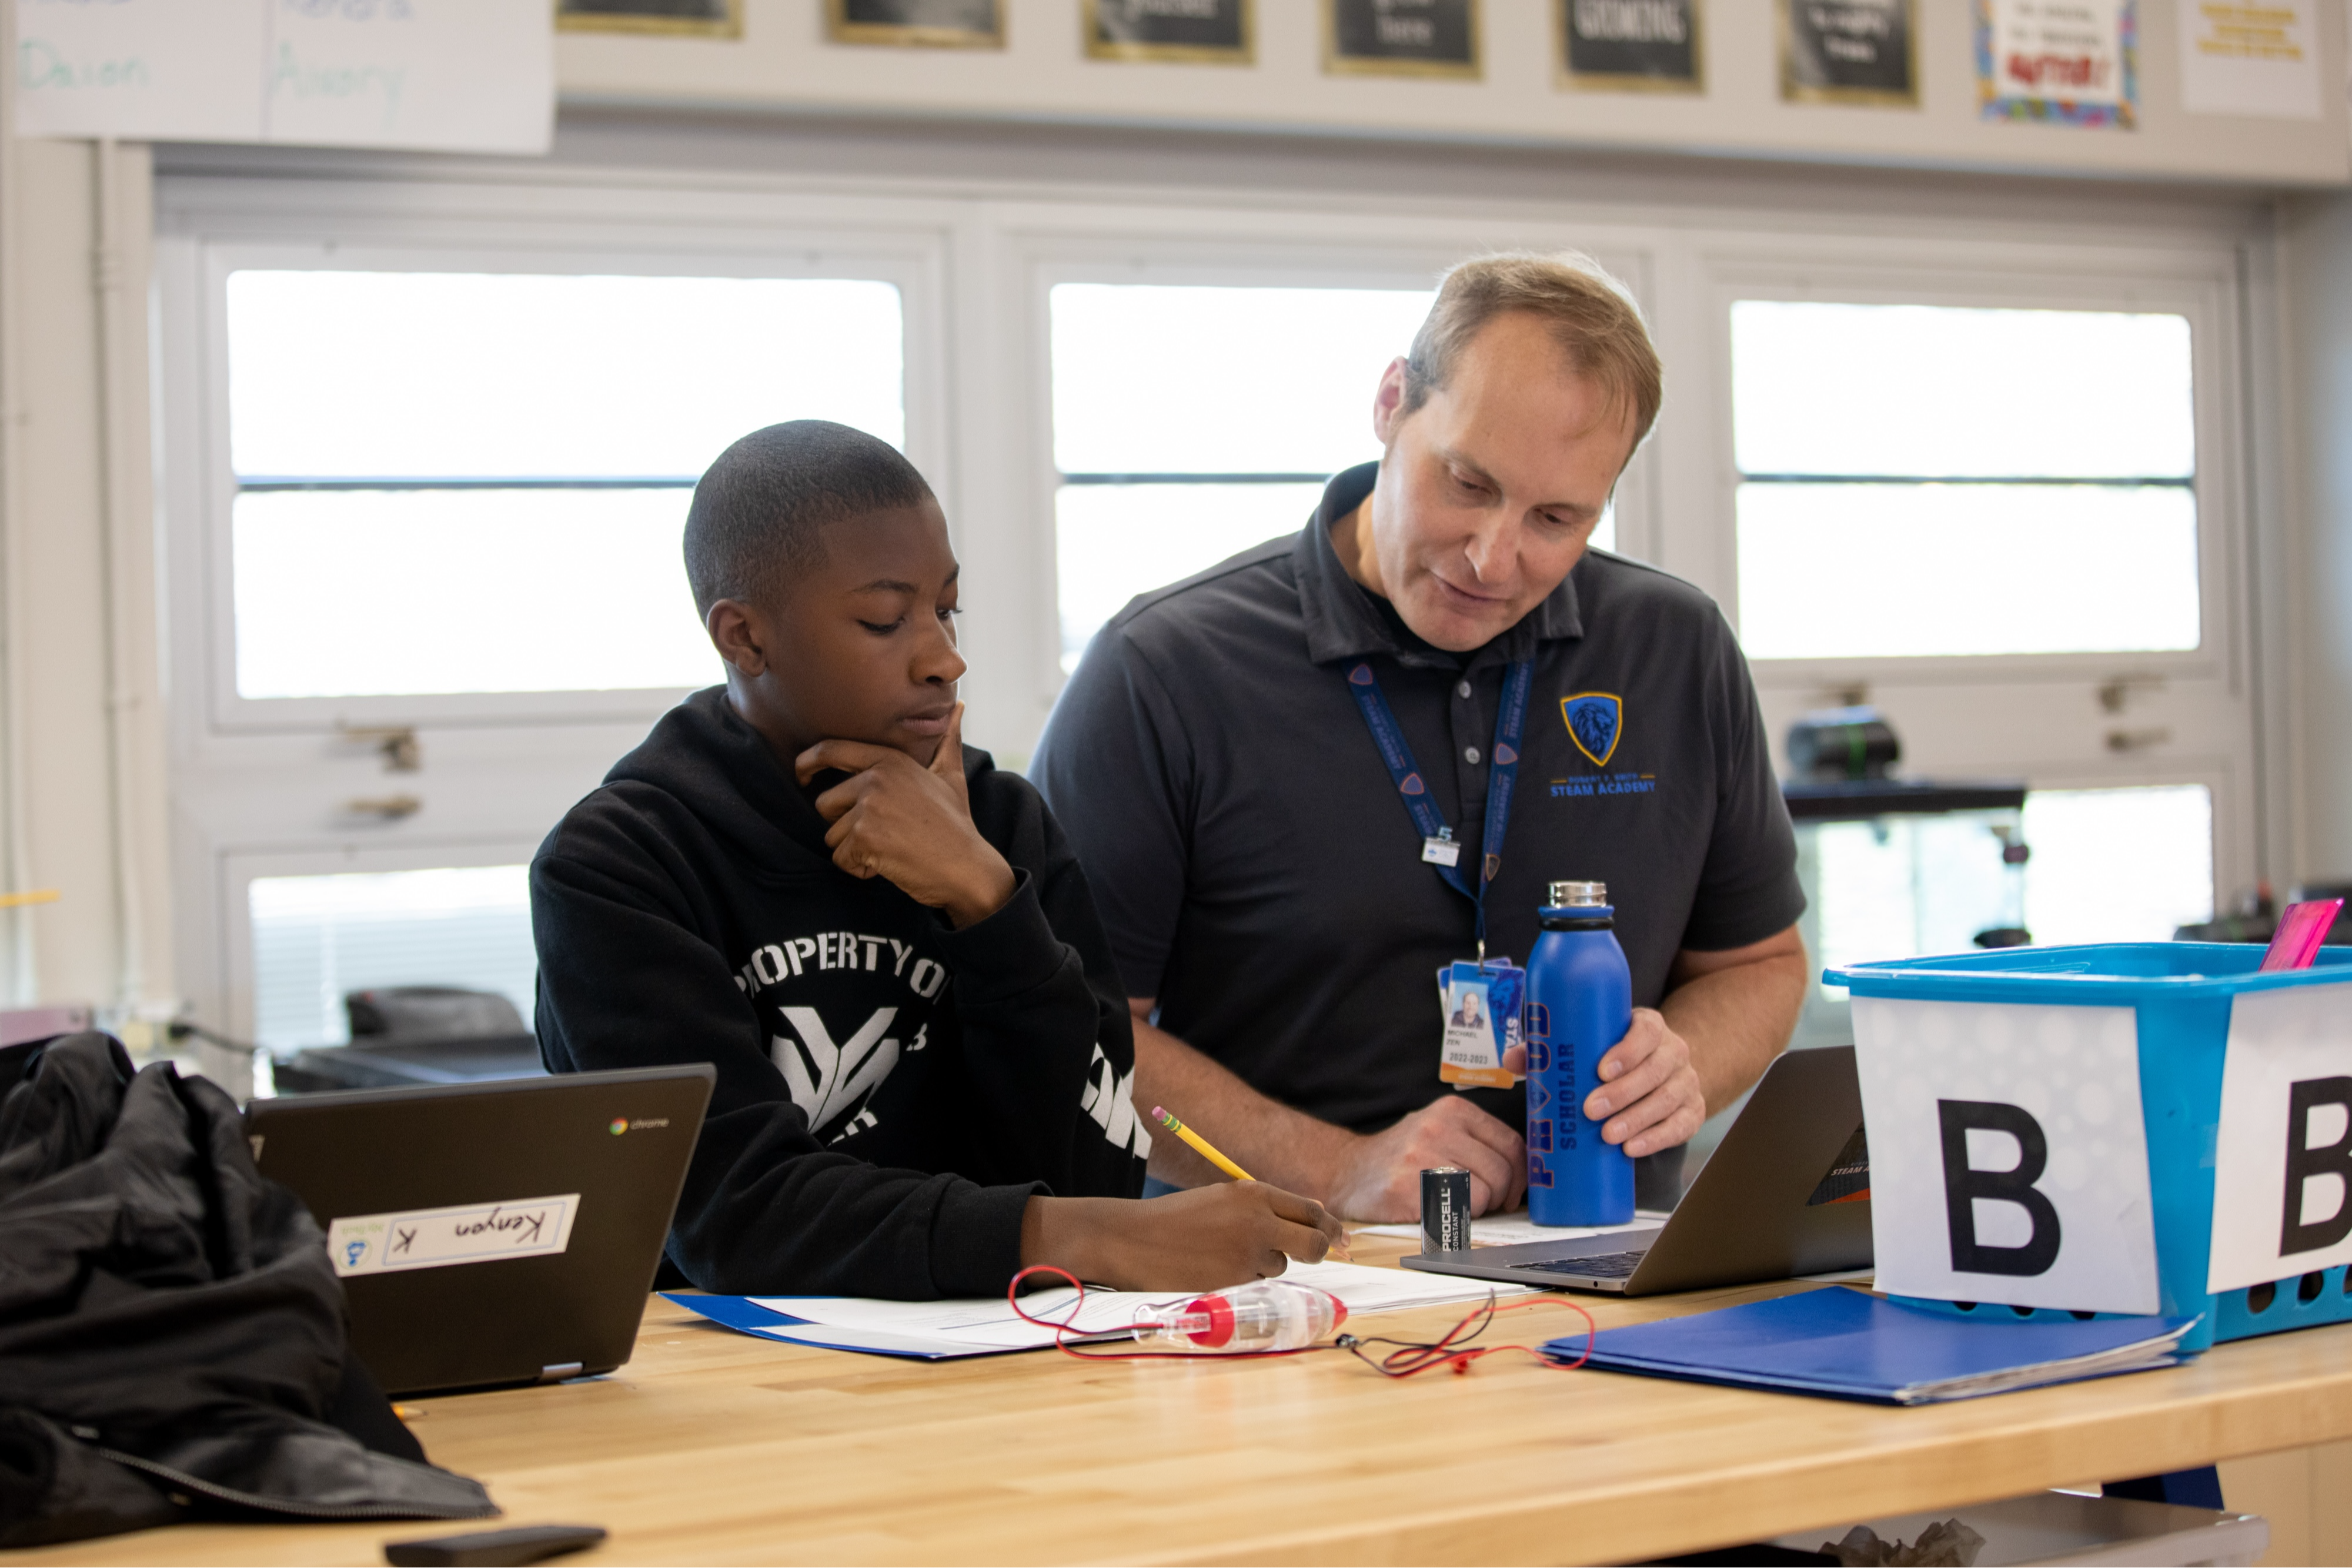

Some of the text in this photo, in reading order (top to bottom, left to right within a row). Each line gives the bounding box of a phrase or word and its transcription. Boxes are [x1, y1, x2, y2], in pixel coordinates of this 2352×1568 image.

[1550, 780, 1655, 797] STEAM ACADEMY
[1447, 1029, 1478, 1039] MICHAEL
[1449, 1052, 1489, 1065] 2022-2023
[1558, 1043, 1577, 1151] SCHOLAR
[1830, 1166, 1863, 1176] STEAM
[2277, 1075, 2352, 1259] B
[1936, 1098, 2062, 1278] B
[455, 1206, 546, 1245] Kenyon
[393, 1227, 417, 1254] K
